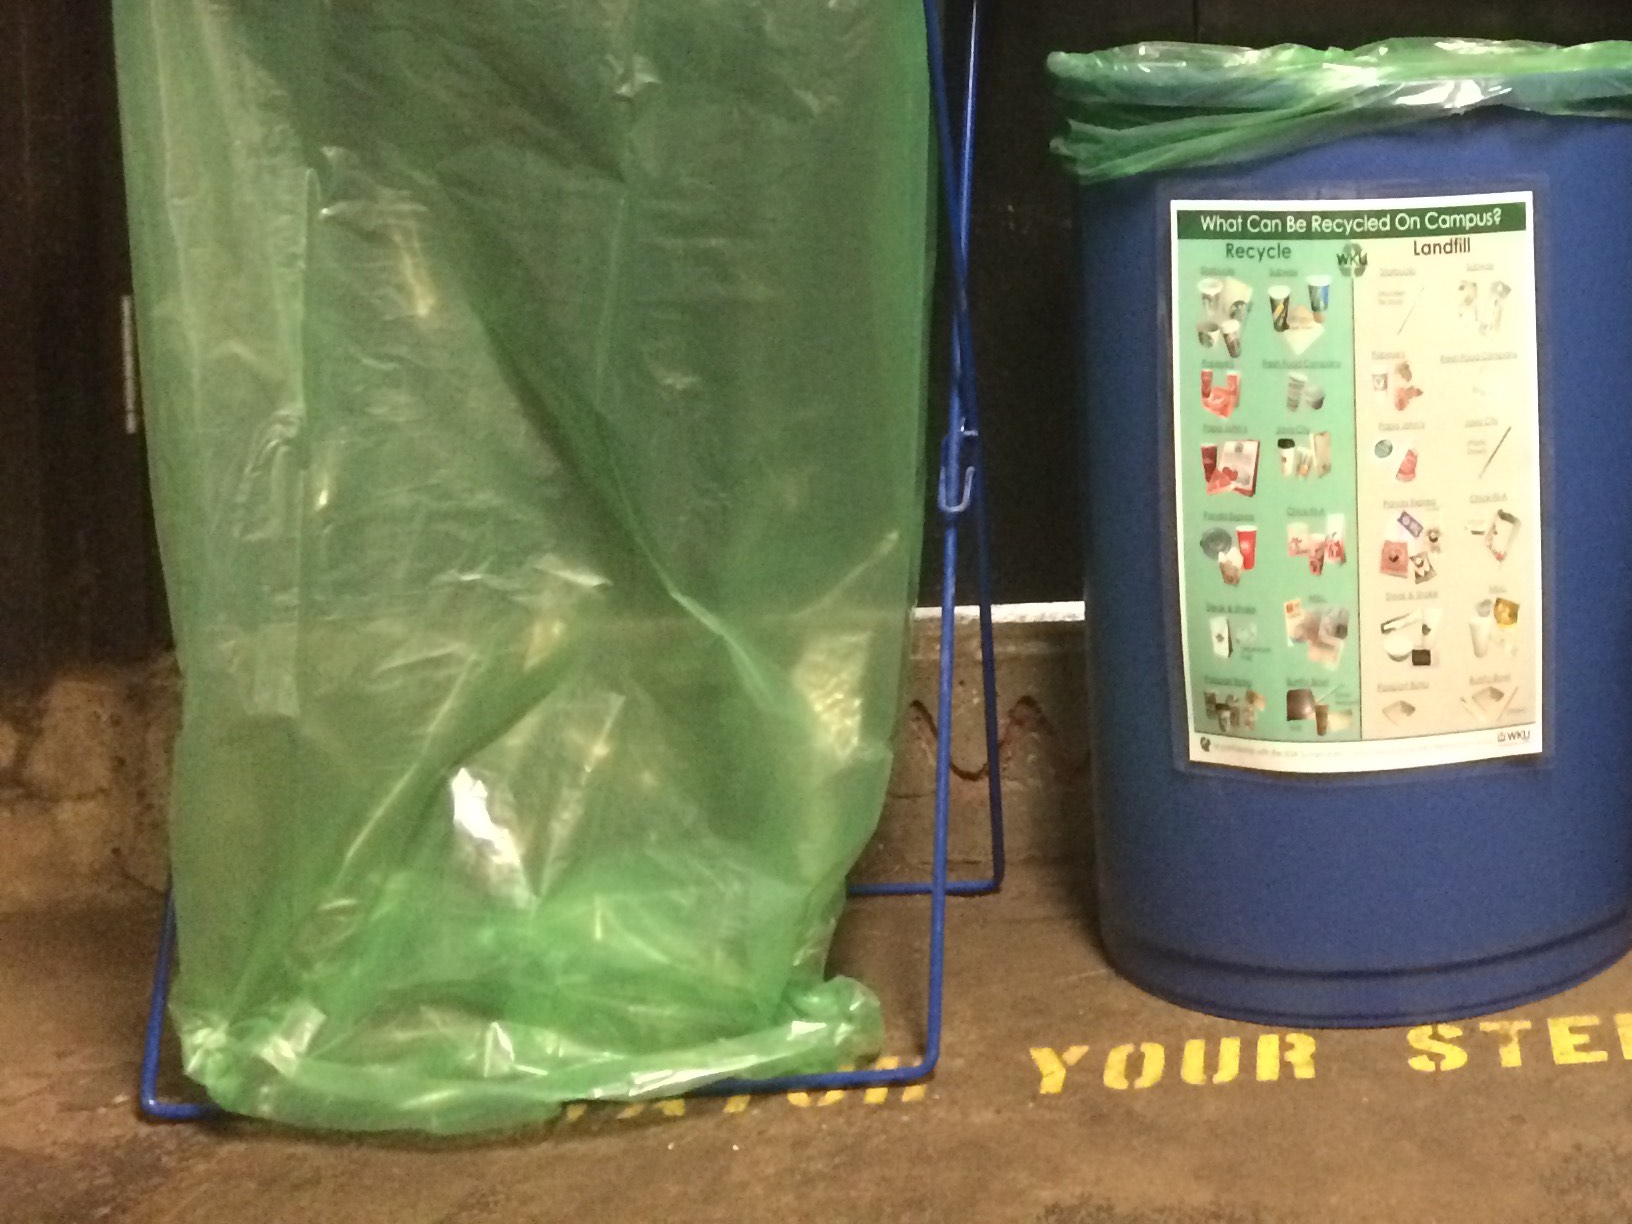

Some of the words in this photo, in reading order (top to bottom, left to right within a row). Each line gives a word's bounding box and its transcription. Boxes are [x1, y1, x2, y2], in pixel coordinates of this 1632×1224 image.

[1200, 214, 1243, 233] What
[1247, 214, 1282, 233] Can
[1286, 215, 1307, 233] Be
[1311, 213, 1391, 236] Recycled
[1395, 212, 1421, 231] On
[1425, 207, 1502, 231] Campus?
[1225, 242, 1292, 263] Recycle
[1413, 236, 1471, 257] Landfill
[1336, 251, 1368, 266] WKU
[1507, 730, 1531, 741] WKU
[1029, 1033, 1316, 1094] YOUR
